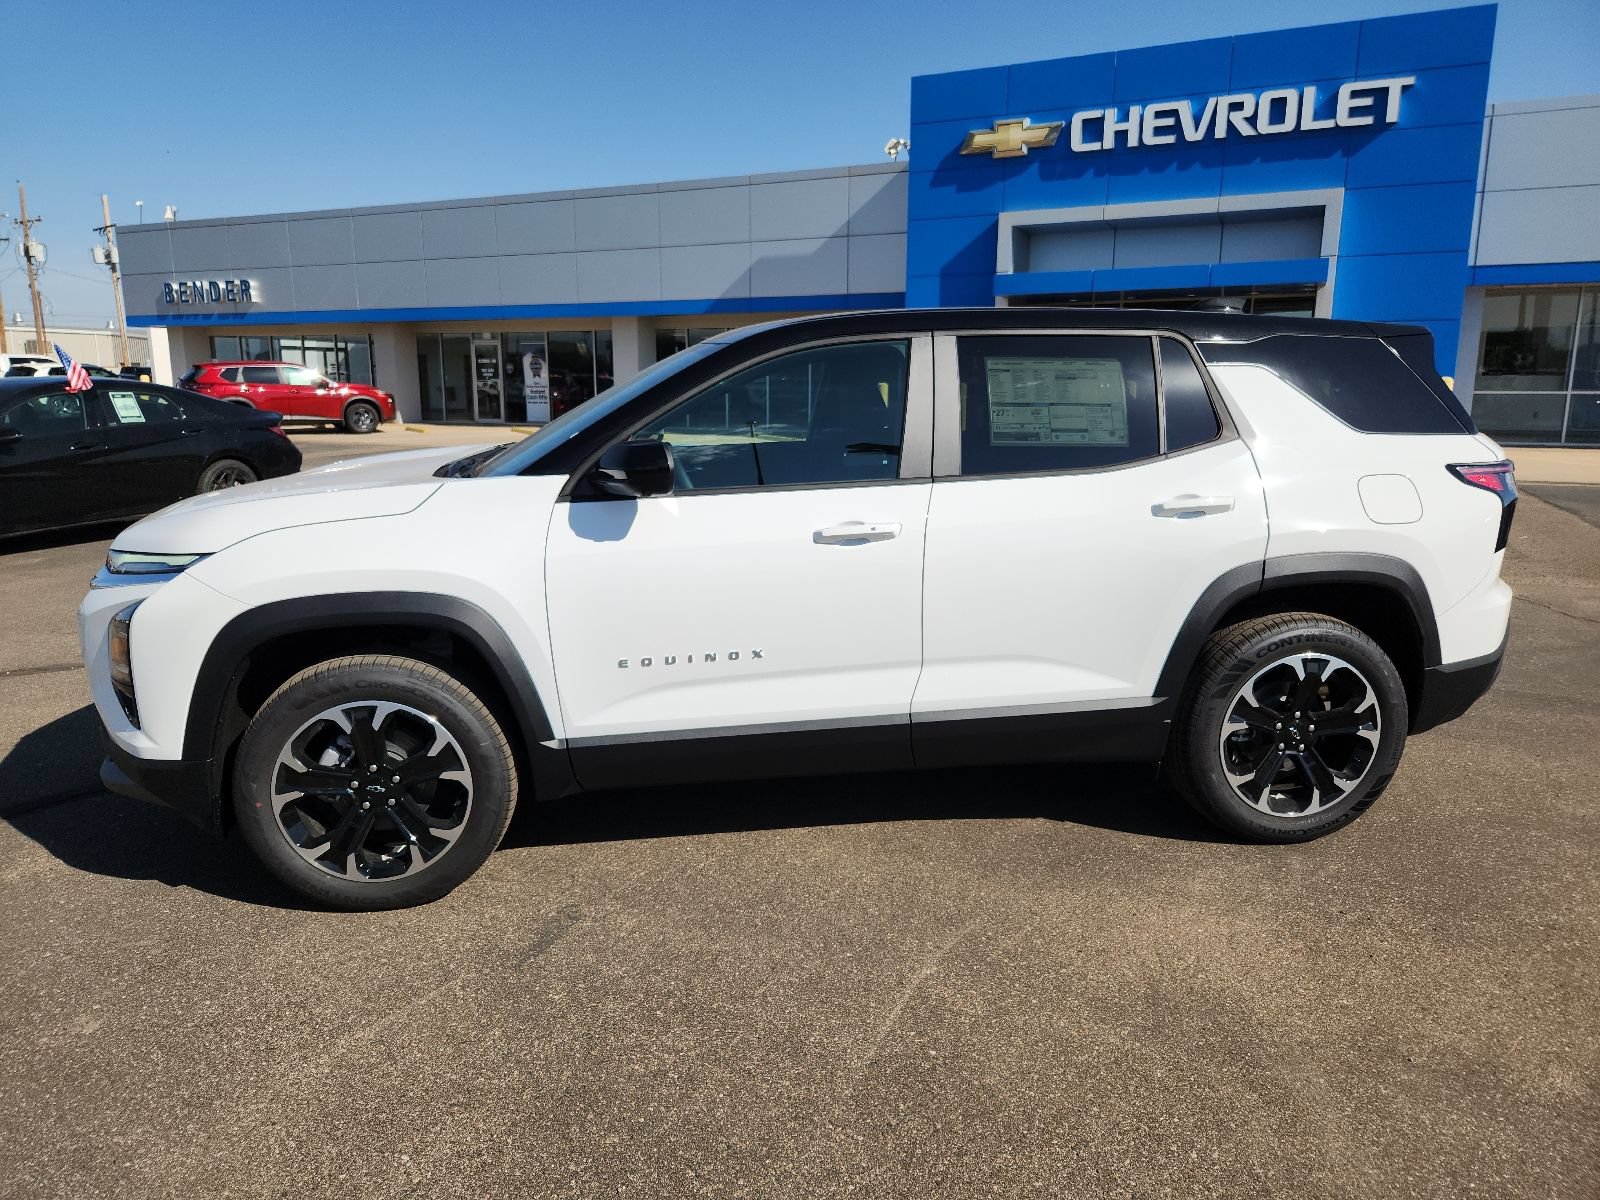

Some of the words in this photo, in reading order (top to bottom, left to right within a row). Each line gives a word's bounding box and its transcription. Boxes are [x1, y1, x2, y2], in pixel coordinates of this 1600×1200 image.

[1070, 76, 1416, 153] CHEVROLET
[163, 279, 254, 304] BENDER
[617, 649, 763, 669] EQUINOX
